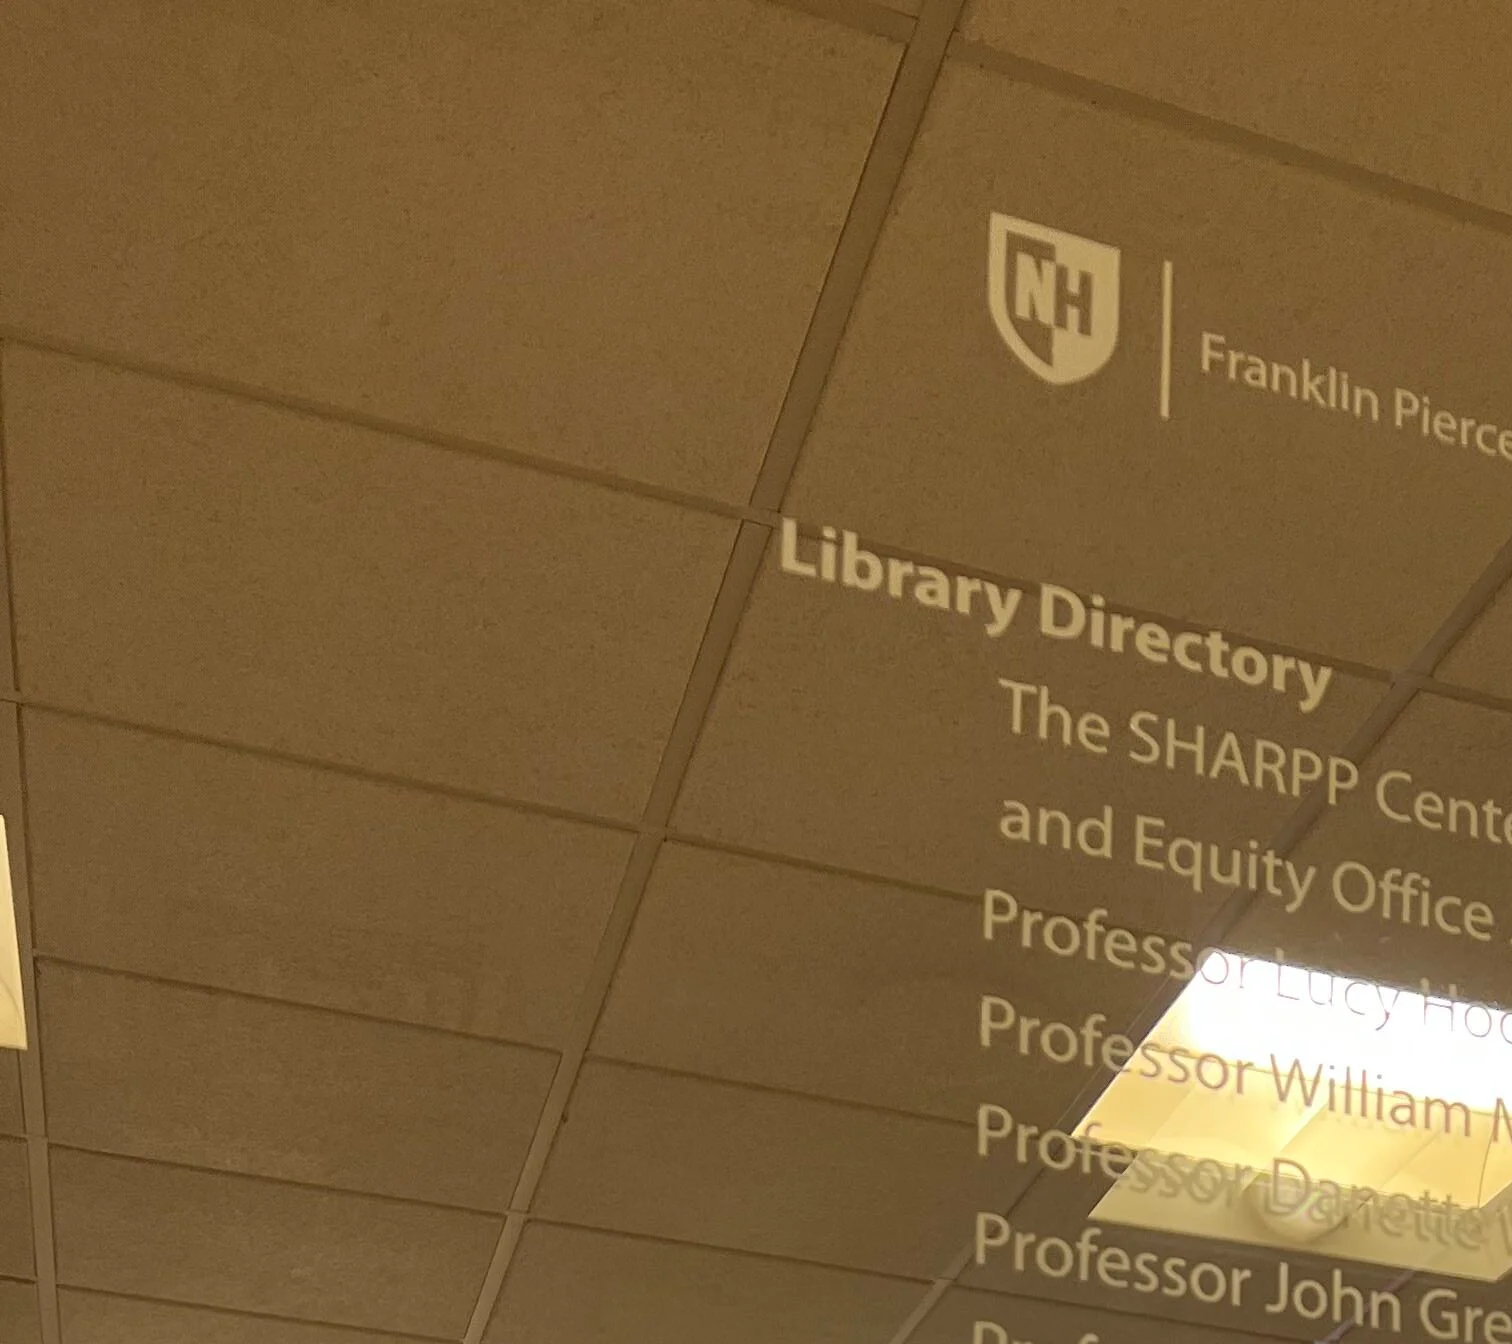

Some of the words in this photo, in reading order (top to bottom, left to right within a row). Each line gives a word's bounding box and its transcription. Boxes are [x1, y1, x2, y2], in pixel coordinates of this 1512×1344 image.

[1015, 251, 1093, 336] NH
[1201, 332, 1379, 422] Franklin
[780, 517, 1022, 637] Library
[1040, 583, 1332, 712] Directory
[999, 679, 1110, 754] The
[1129, 712, 1358, 804] SHARPP
[1001, 799, 1113, 858] and
[1134, 816, 1316, 912] Equity
[1332, 861, 1494, 941] Office
[983, 888, 1260, 989] Professor
[1276, 947, 1397, 1031] Lucy
[979, 995, 1253, 1096] Professor
[1270, 1052, 1471, 1138] William
[976, 1103, 1252, 1205] Professor
[1271, 1157, 1484, 1250] Danette
[975, 1212, 1251, 1307] Professor
[1266, 1262, 1400, 1331] John
